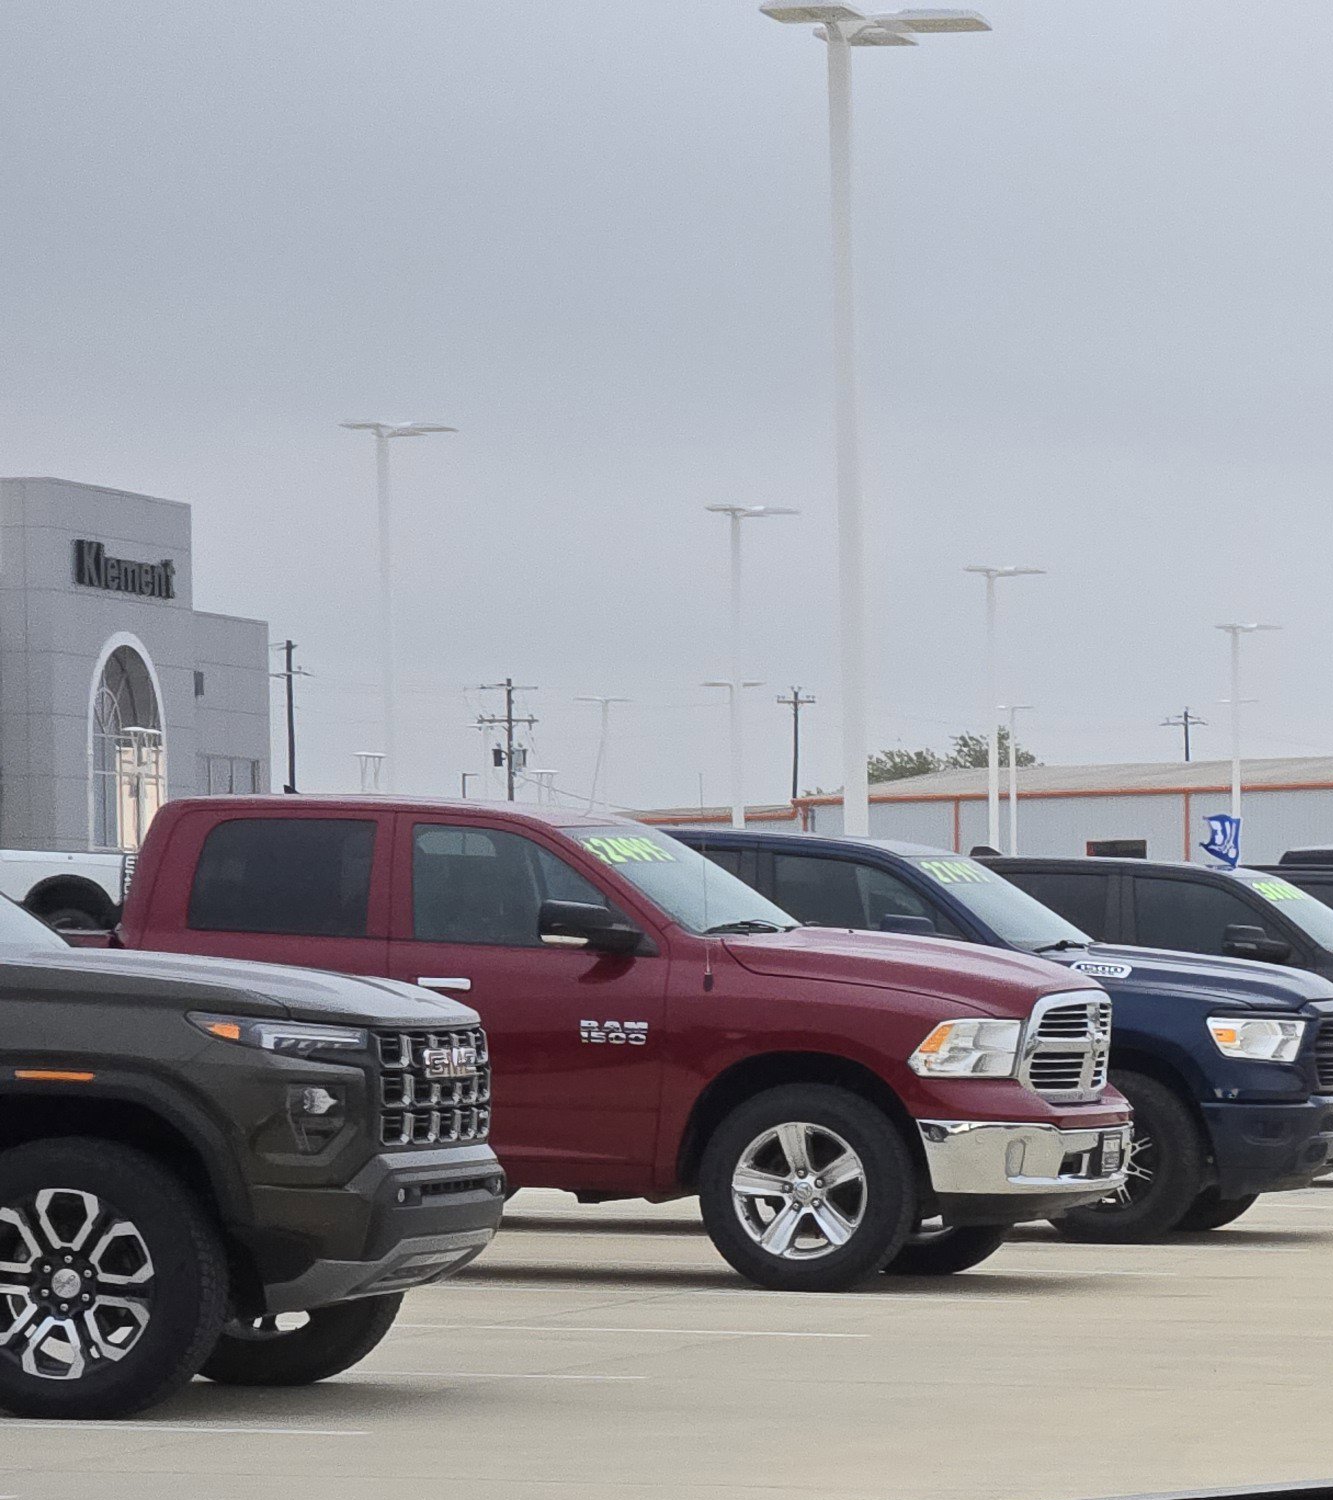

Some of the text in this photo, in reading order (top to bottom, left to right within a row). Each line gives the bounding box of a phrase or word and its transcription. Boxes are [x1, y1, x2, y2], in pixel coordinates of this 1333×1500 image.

[75, 539, 175, 599] Klement
[580, 1020, 649, 1034] RAM
[580, 1031, 647, 1046] 1500
